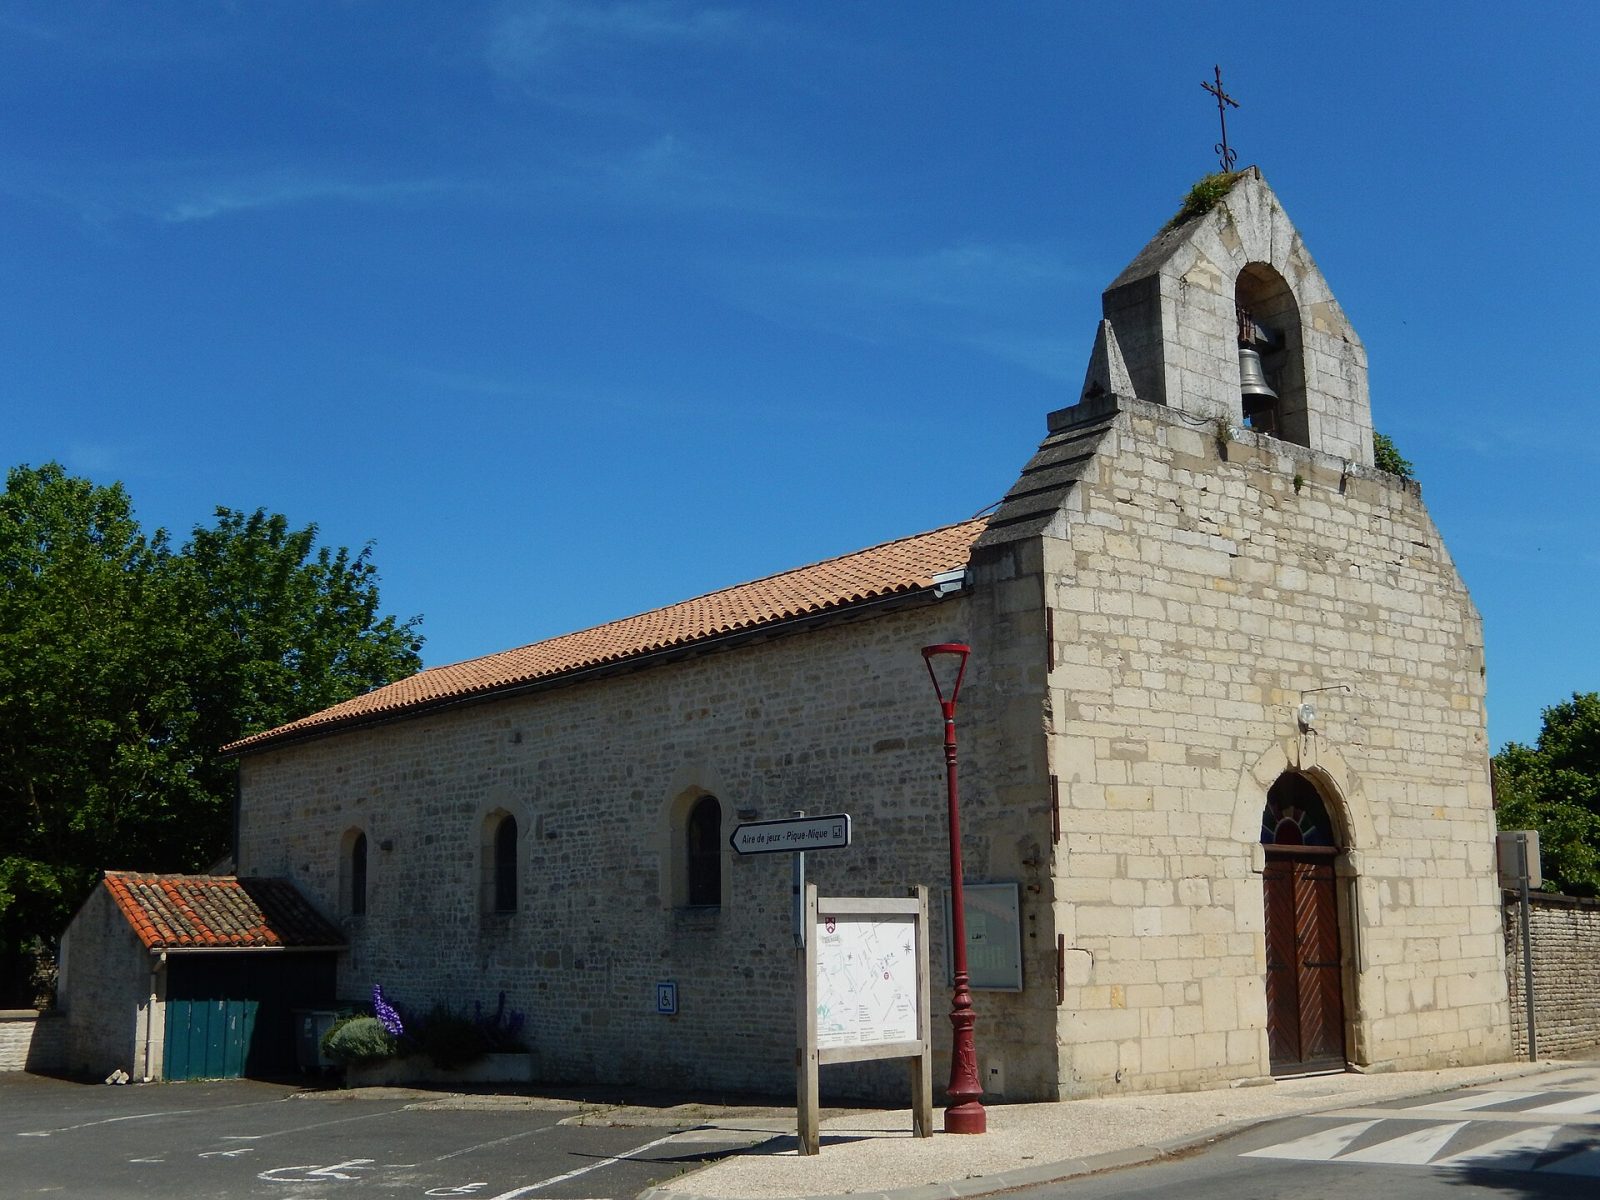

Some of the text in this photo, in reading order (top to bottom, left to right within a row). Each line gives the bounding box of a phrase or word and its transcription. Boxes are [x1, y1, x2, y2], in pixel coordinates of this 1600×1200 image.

[742, 835, 755, 844] Aire
[757, 834, 764, 843] de
[766, 833, 780, 844] jeux
[787, 829, 828, 842] Pique-Nique
